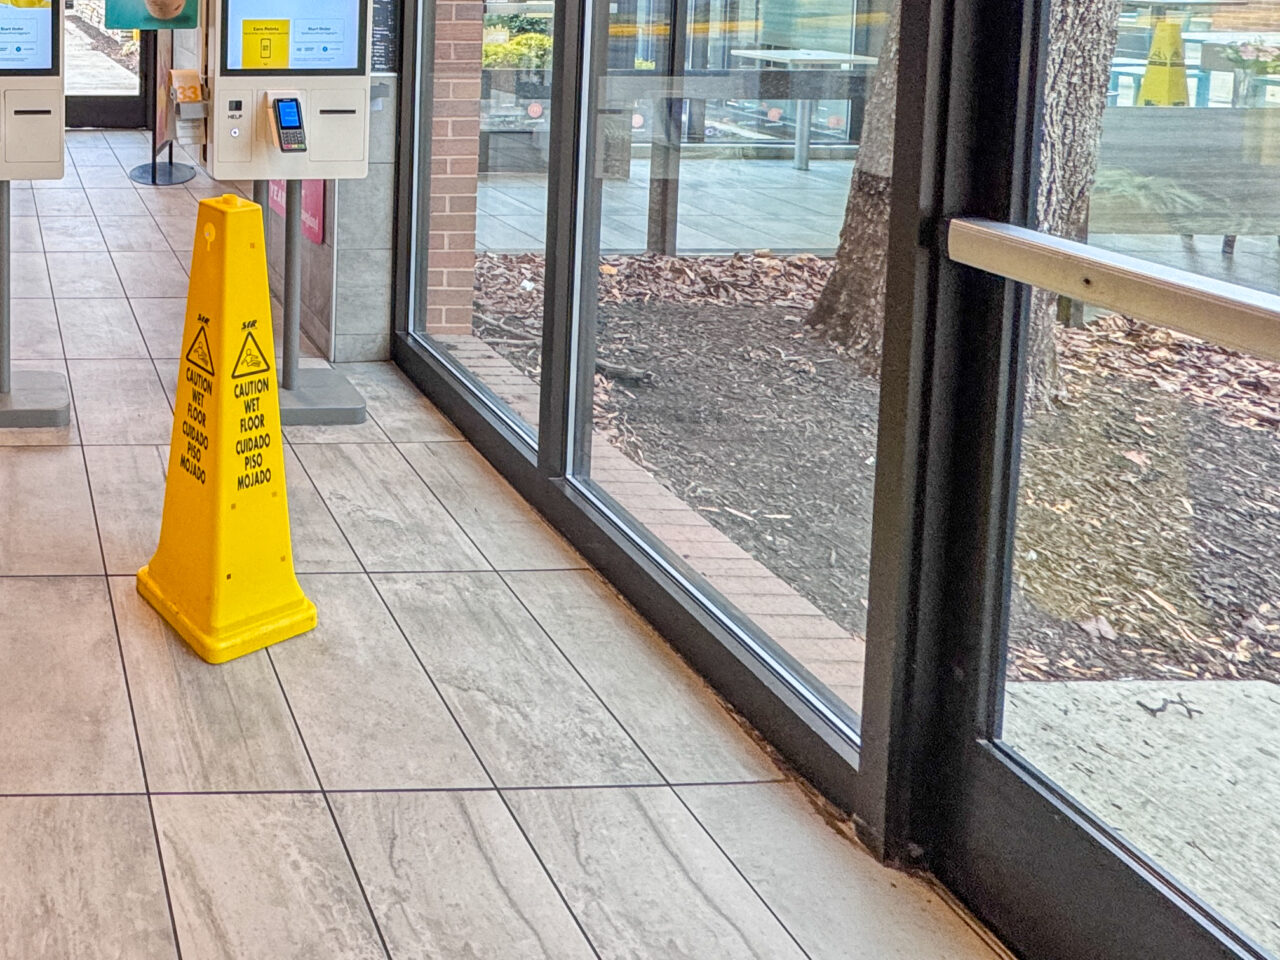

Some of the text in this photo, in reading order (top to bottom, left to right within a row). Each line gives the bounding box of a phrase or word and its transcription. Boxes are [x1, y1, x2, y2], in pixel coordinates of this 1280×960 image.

[177, 85, 199, 102] 33
[186, 368, 212, 395] CAUTION
[234, 377, 269, 399] CAUTION
[192, 387, 204, 408] WET
[244, 397, 260, 414] WET
[188, 404, 206, 428] FLOOR
[240, 414, 265, 433] FLOOR
[182, 421, 209, 450] CUIDADO
[236, 433, 270, 456] CUIDADO
[187, 442, 201, 463] PISO
[245, 453, 263, 471] PISO
[180, 454, 206, 485] MOJADO
[237, 468, 271, 491] MOJADO
